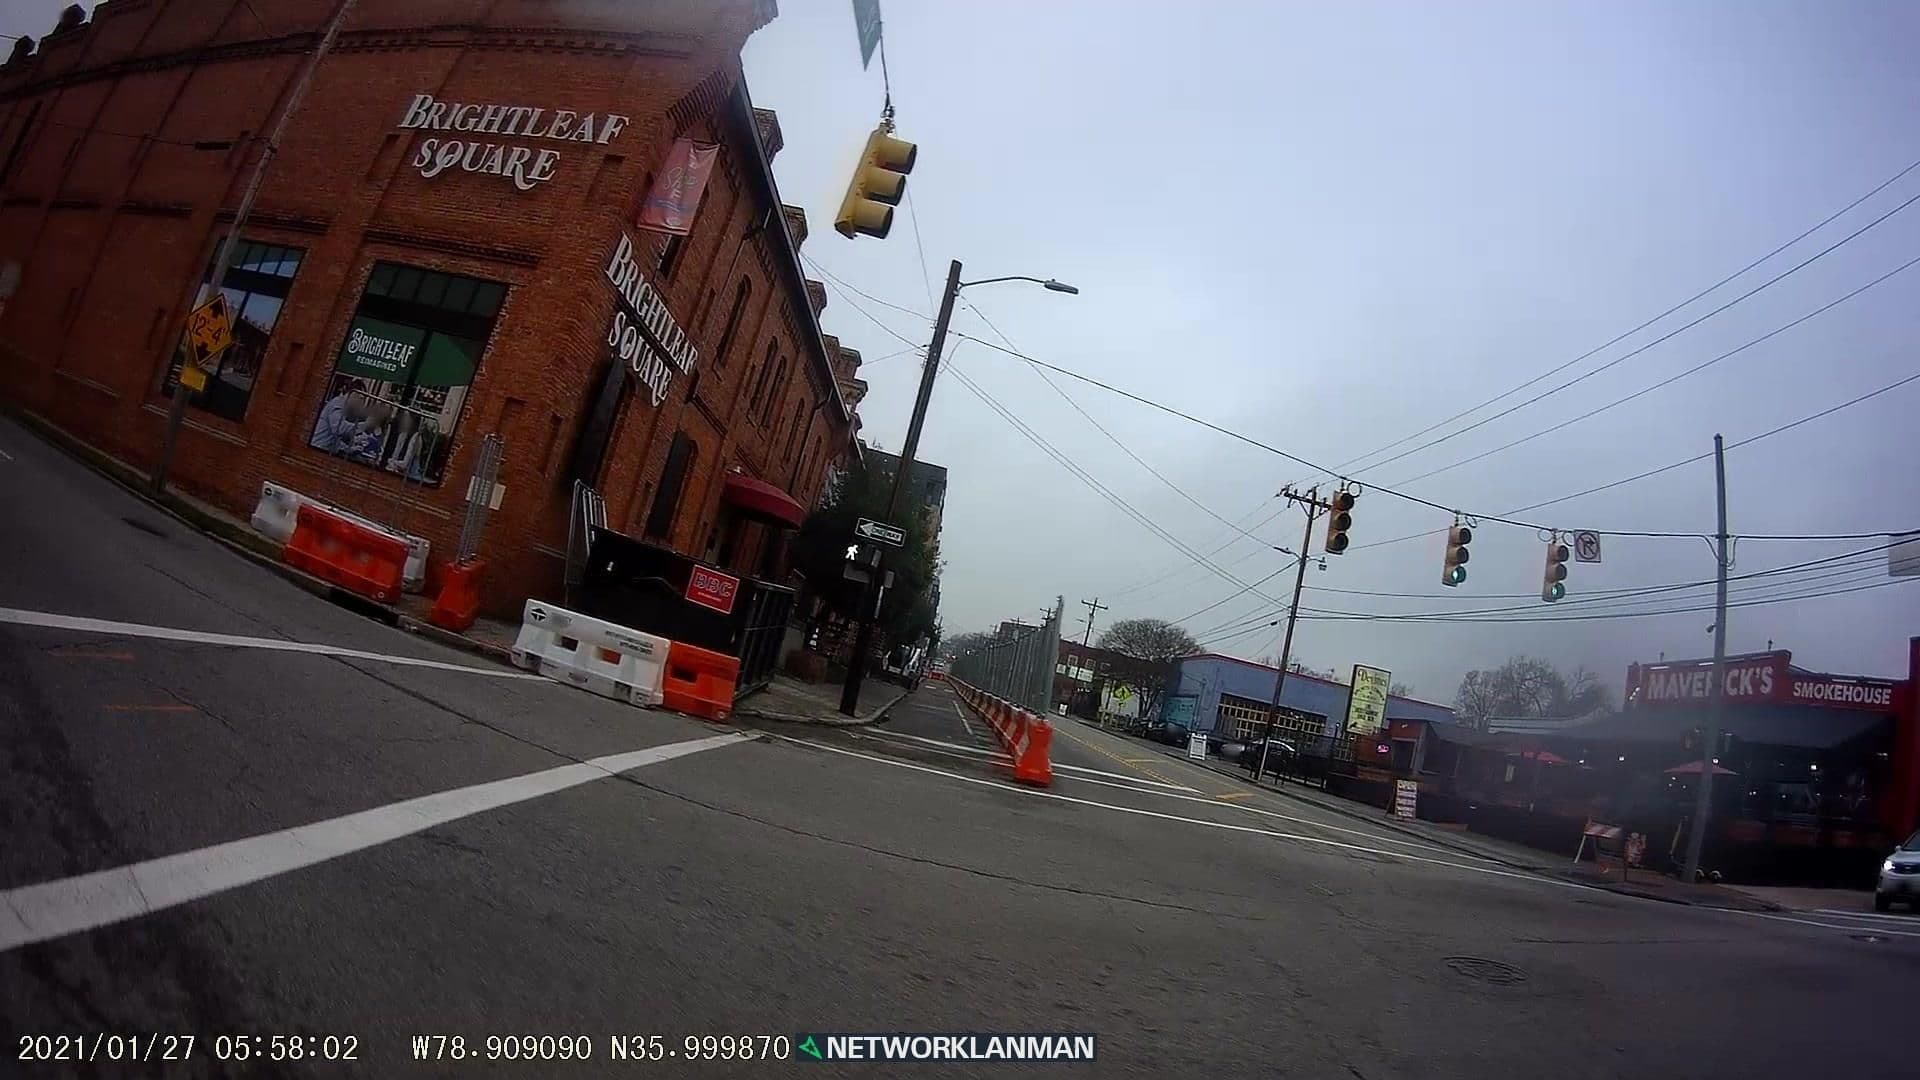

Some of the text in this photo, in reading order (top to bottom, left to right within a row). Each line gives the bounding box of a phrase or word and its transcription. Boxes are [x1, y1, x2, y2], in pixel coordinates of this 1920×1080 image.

[397, 94, 629, 144] BRIGHTLEAF
[412, 138, 560, 190] SQUARE
[605, 231, 698, 375] BRIGHTLEAF
[348, 328, 415, 367] BRIGHTLEAF
[608, 312, 671, 407] SQUARE
[692, 572, 733, 598] BBC
[1793, 682, 1891, 705] SMOKEHOUSE
